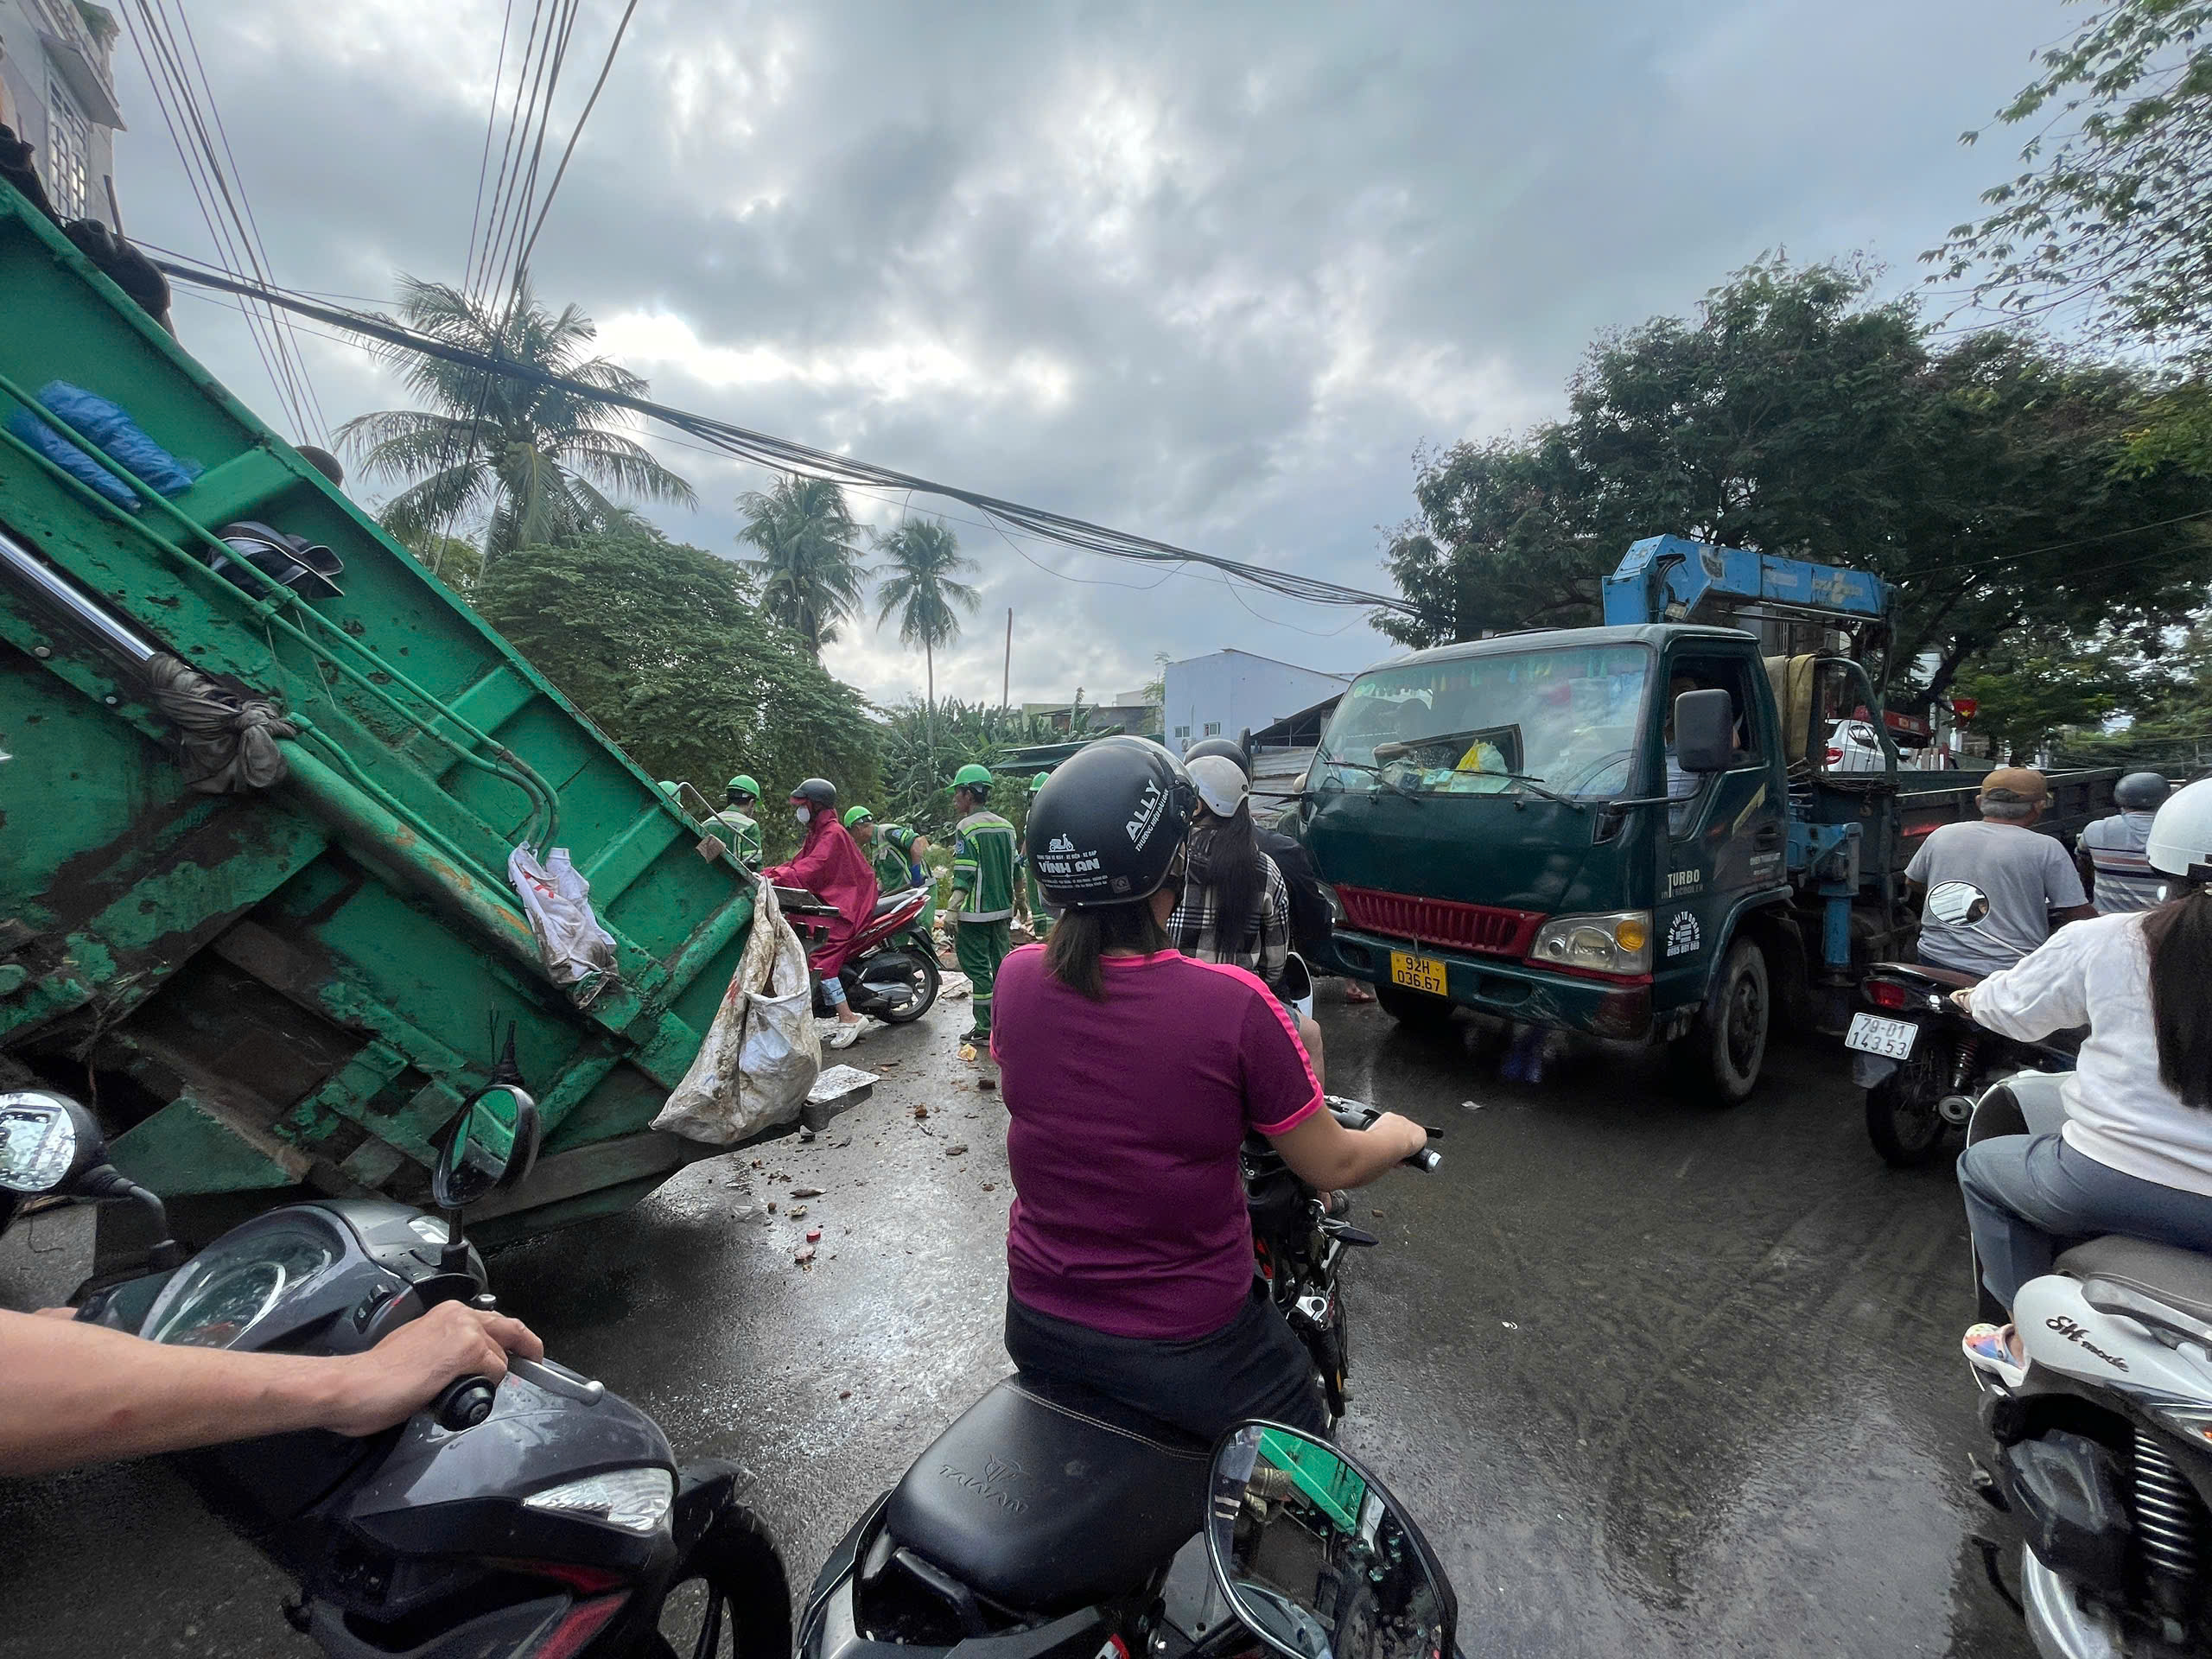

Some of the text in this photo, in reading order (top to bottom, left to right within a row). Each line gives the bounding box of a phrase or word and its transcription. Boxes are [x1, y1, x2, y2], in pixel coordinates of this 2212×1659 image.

[1126, 779, 1161, 841] ALLY
[1038, 858, 1101, 874] VĨNH AN
[1667, 868, 1700, 898] TURBO
[1405, 957, 1430, 975] 92H
[1396, 969, 1440, 992] 036.67
[1860, 1018, 1905, 1039] 79-D1
[1853, 1031, 1907, 1056] 143.53
[2045, 1315, 2129, 1373] SH mode
